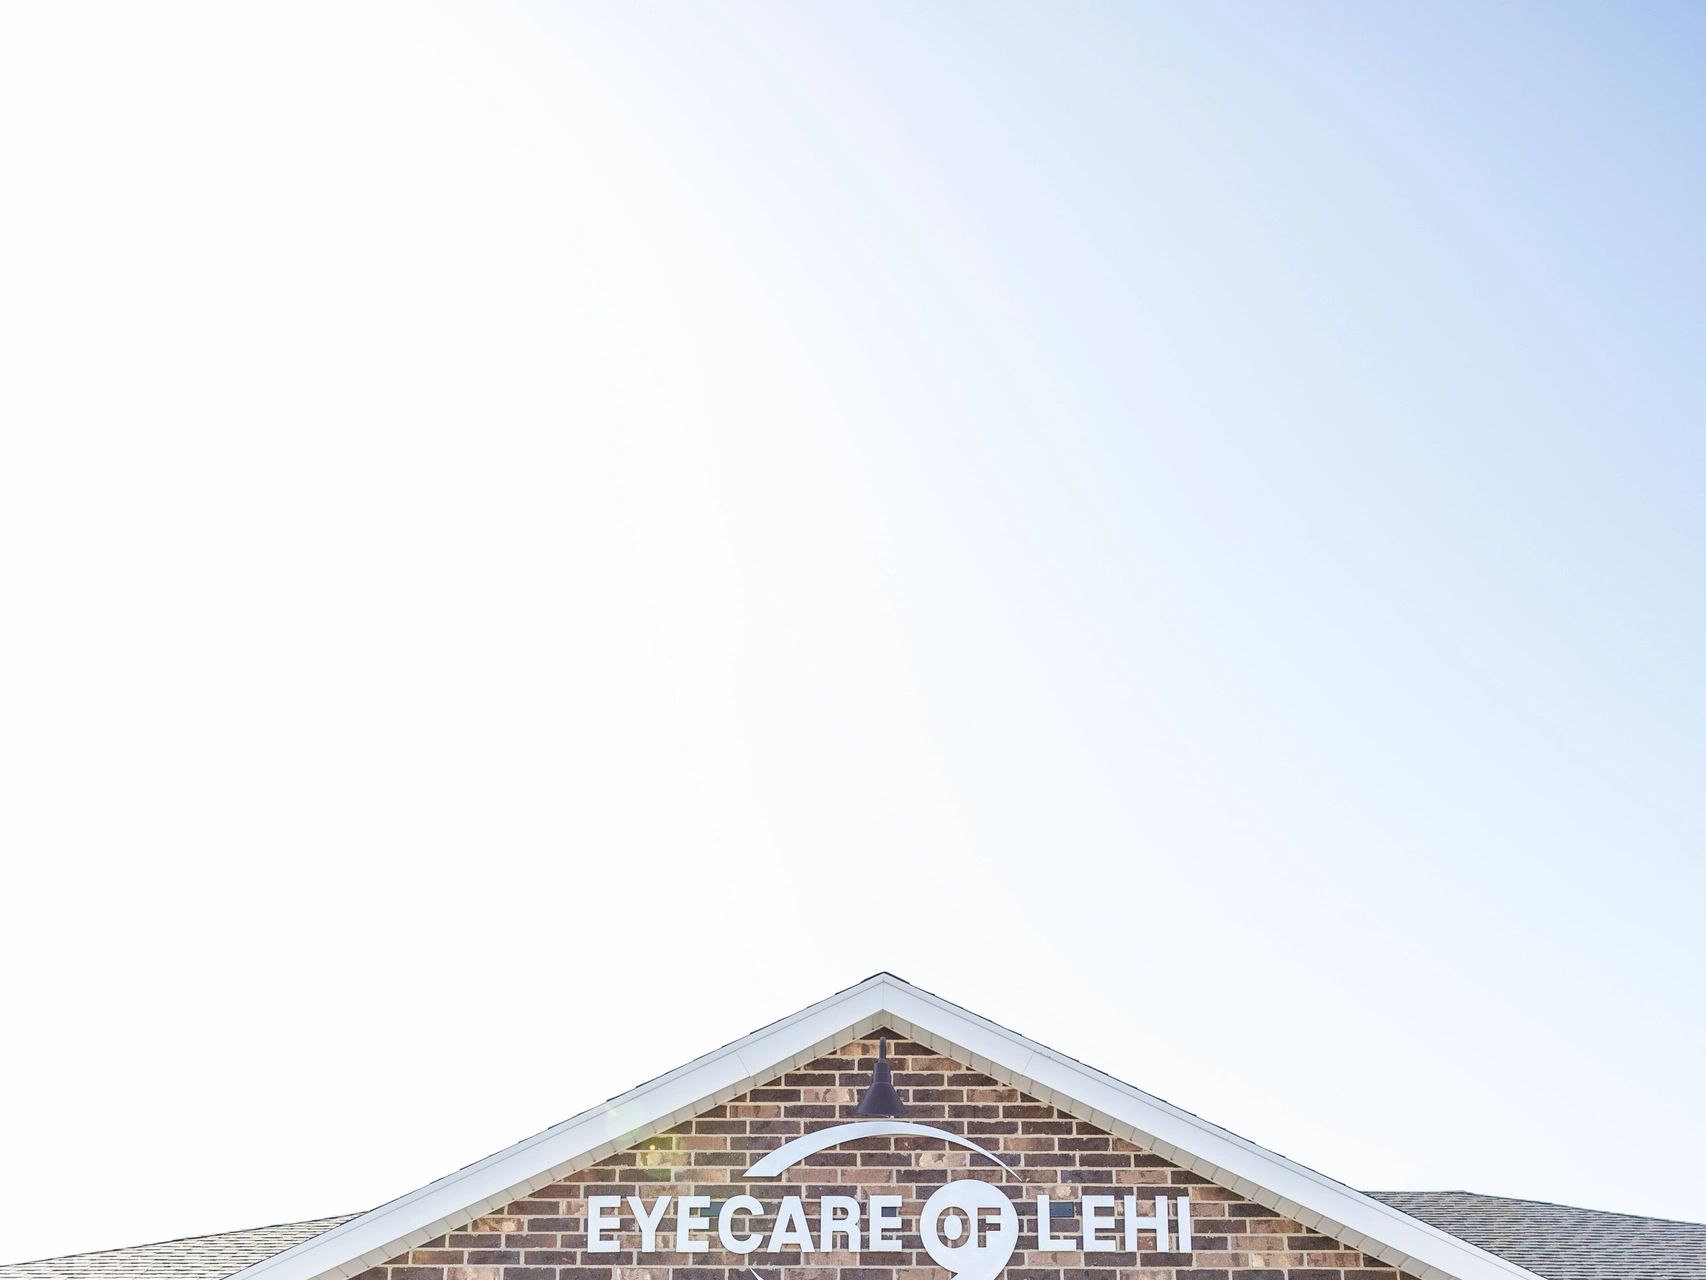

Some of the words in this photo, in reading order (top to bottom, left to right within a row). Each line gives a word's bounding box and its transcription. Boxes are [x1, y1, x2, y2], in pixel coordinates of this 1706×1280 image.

[587, 1195, 903, 1254] EYECARE
[935, 1206, 1001, 1249] OF
[1037, 1194, 1192, 1253] LEHI
